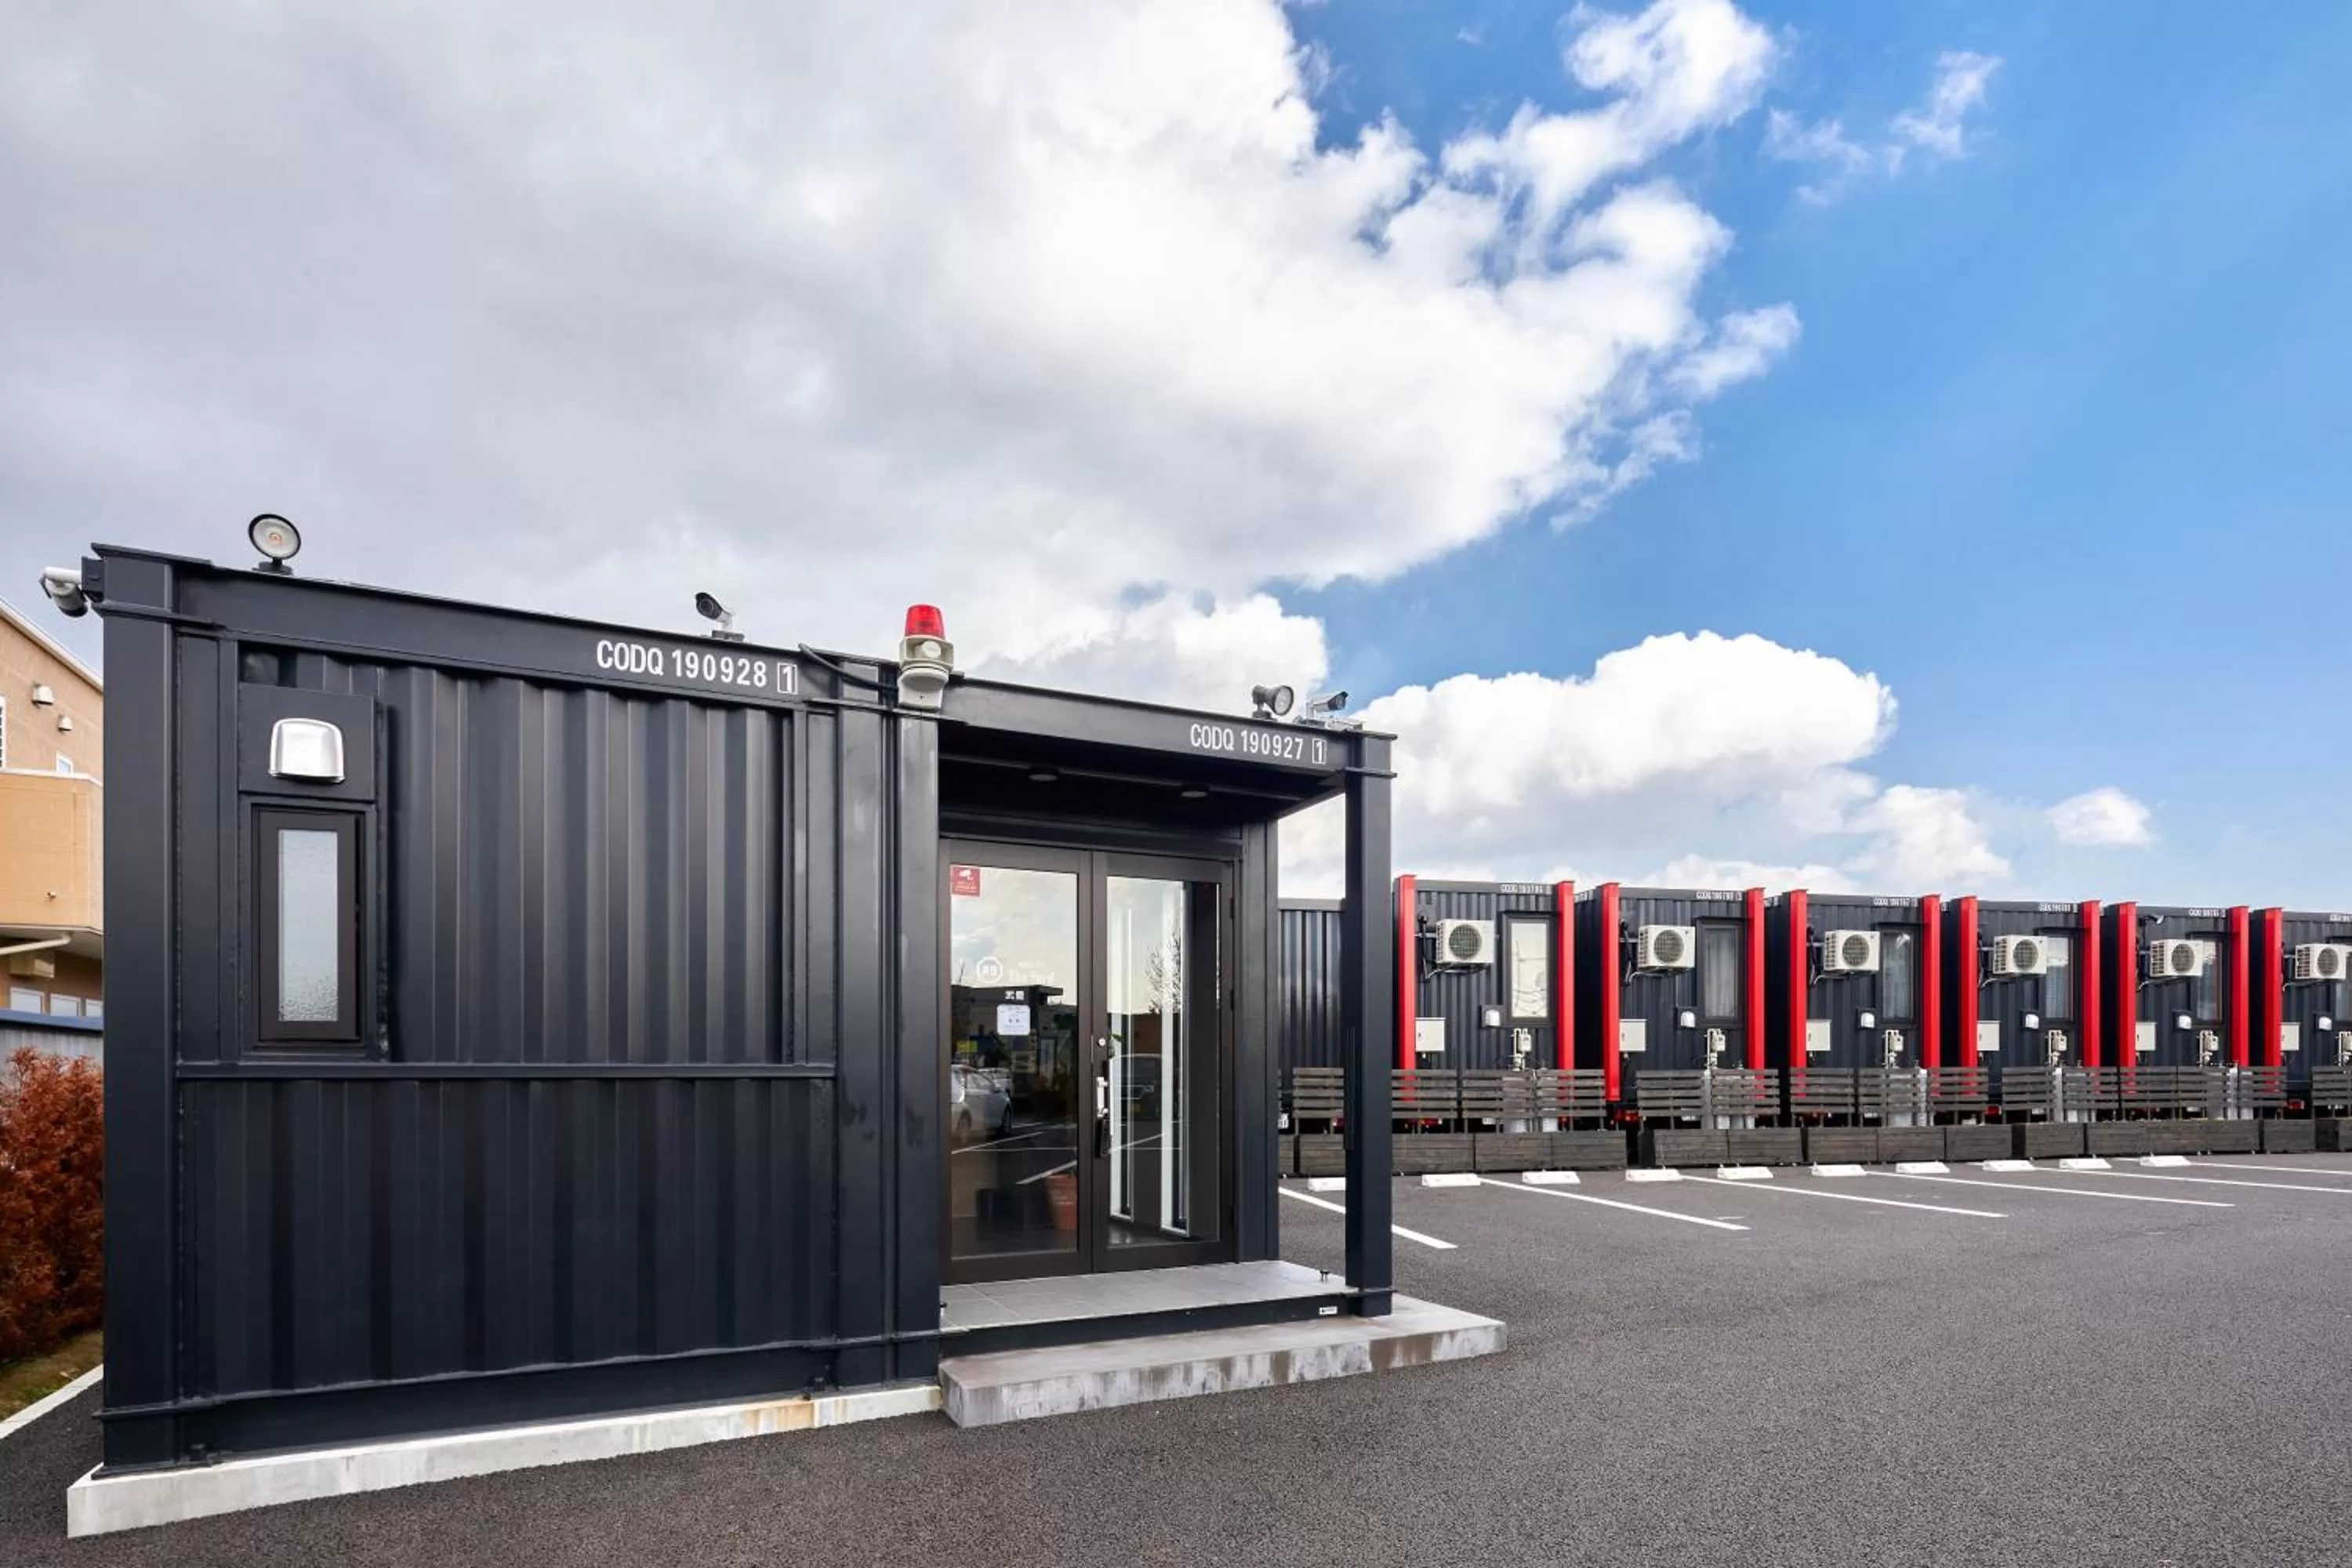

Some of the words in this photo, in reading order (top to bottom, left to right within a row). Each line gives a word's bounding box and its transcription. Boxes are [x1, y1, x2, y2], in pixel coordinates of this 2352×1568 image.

[597, 640, 663, 676] CODQ
[672, 649, 767, 687] 190928
[780, 664, 794, 695] 1
[1191, 724, 1234, 751] CODQ
[1242, 731, 1303, 760] 190927
[1315, 739, 1324, 764] 1
